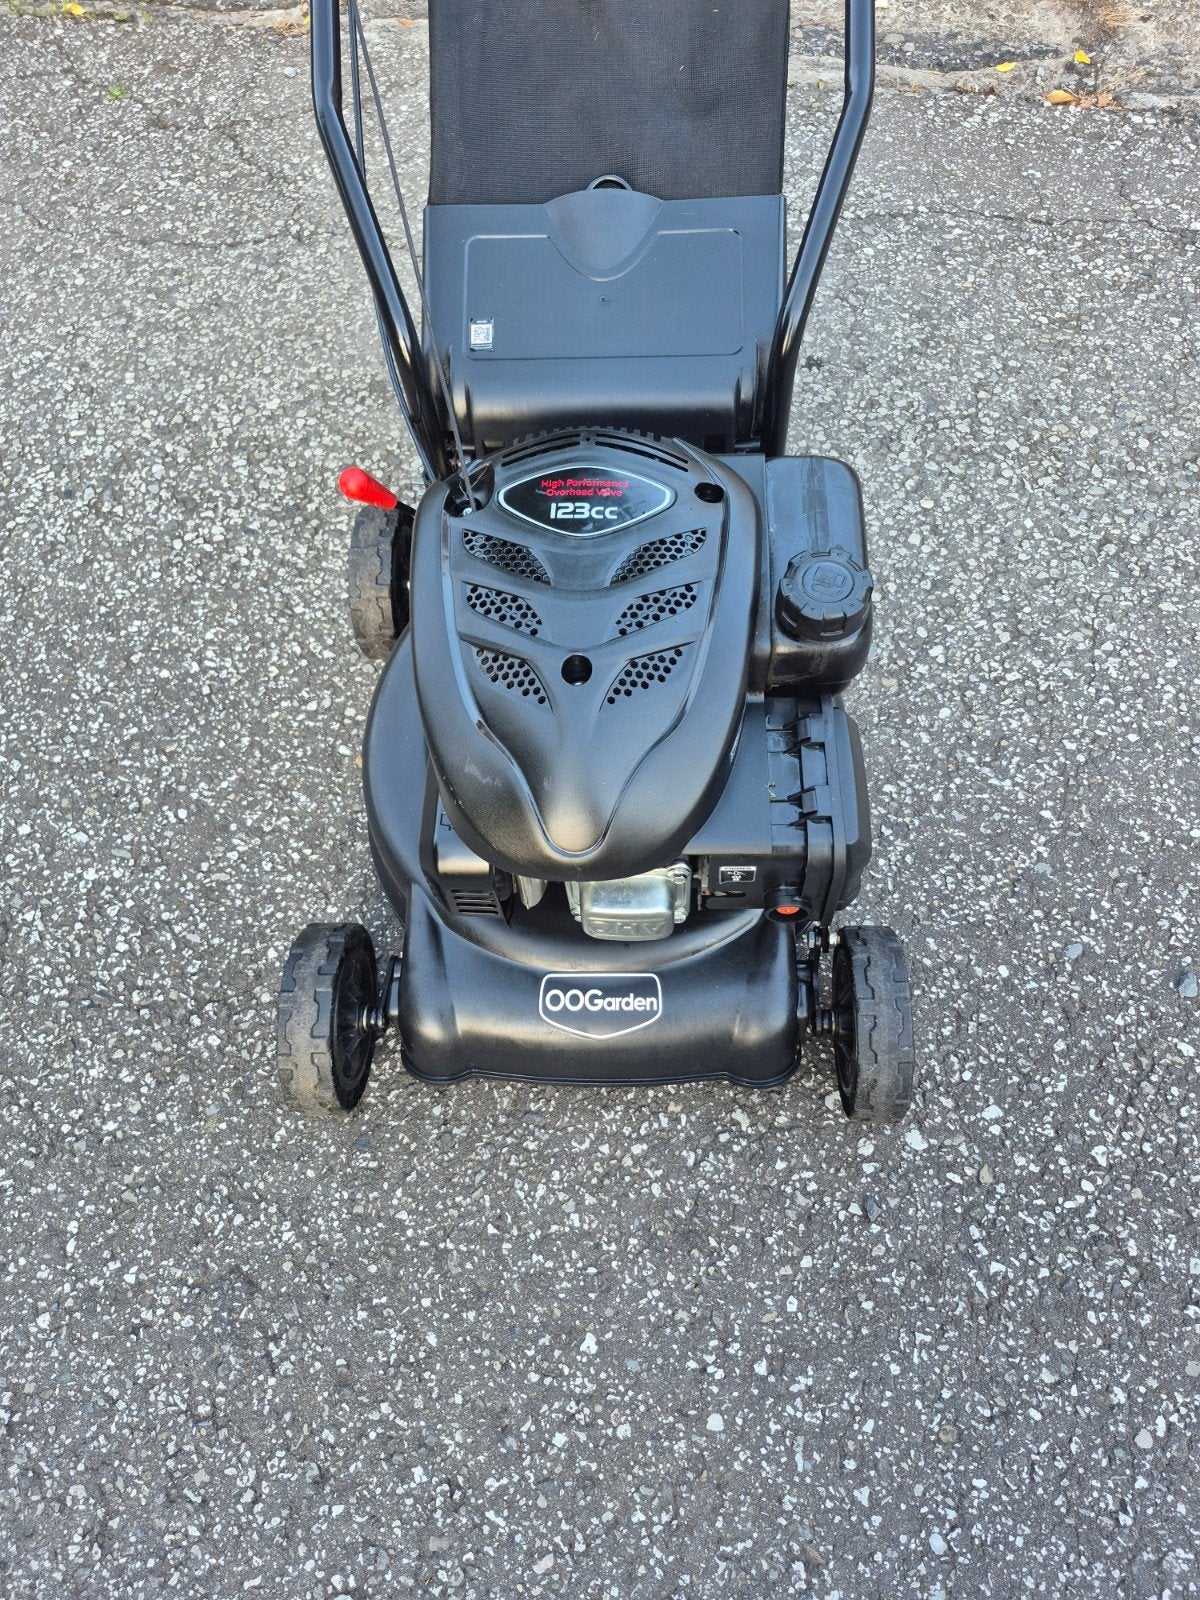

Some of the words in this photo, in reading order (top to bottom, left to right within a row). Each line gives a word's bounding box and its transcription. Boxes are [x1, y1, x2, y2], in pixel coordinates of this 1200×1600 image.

[541, 480, 564, 488] High
[566, 479, 628, 488] Performance
[546, 488, 594, 496] Overhead
[597, 488, 622, 496] Valve
[550, 502, 618, 519] 123cc
[545, 989, 658, 1011] OOGarden
